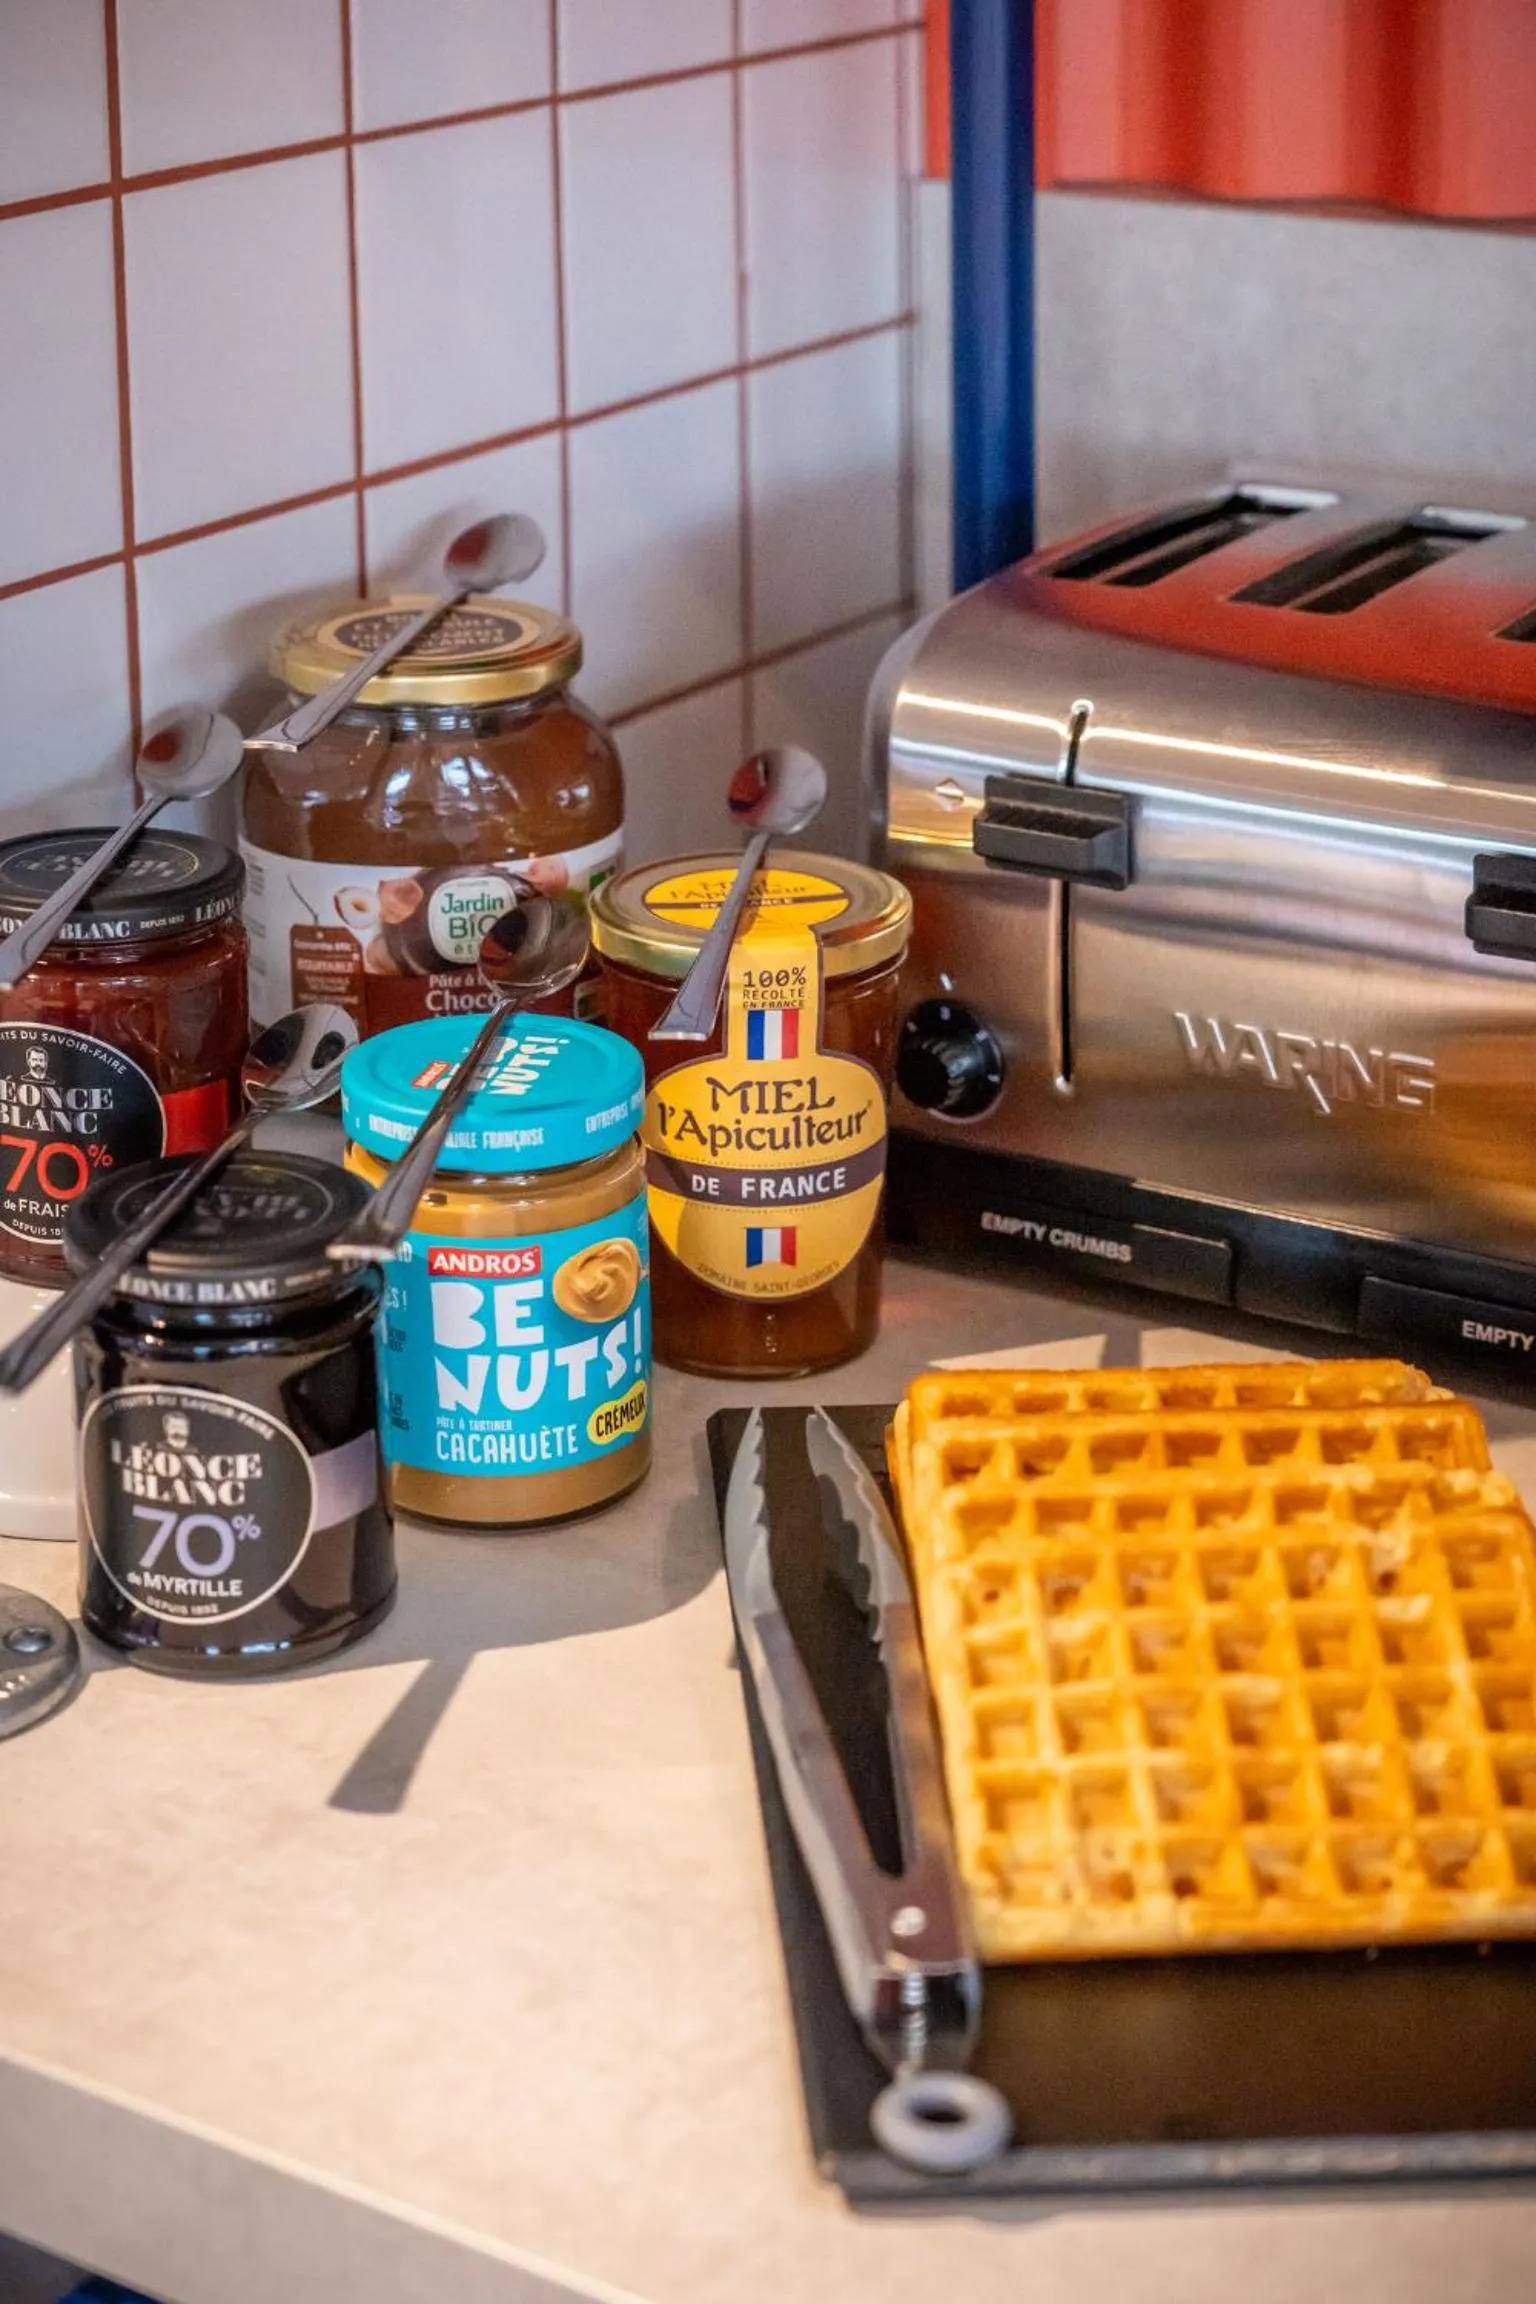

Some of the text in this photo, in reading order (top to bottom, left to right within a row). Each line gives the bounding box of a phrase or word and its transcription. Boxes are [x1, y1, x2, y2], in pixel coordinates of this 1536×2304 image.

[441, 891, 504, 914] Jardin
[59, 920, 130, 939] BLANC
[429, 974, 462, 989] Pâte
[465, 974, 474, 987] à
[743, 965, 807, 988] 100%
[425, 989, 501, 1012] Choco
[743, 999, 805, 1010] EN FRANCE
[20, 1030, 38, 1040] DU
[41, 1031, 127, 1075] SAVOIR-FAIRE
[487, 1035, 571, 1096] NUTS!
[0, 1075, 114, 1110] ÉONCE
[706, 1076, 835, 1115] MIEL
[368, 1112, 419, 1142] ENTREPRIS
[483, 1127, 544, 1152] FRANÇAISE
[658, 1098, 873, 1157] l'Apiculteur
[1, 1133, 114, 1200] 70%
[692, 1166, 847, 1199] DE FRANCE
[4, 1199, 70, 1218] de FRAIS
[12, 1218, 47, 1236] DEPUIS
[980, 1211, 1133, 1263] EMPTY CRUMBS
[432, 1251, 536, 1273] ANDROS
[118, 1270, 193, 1303] ÉONCE
[197, 1276, 278, 1303] BLANC
[430, 1278, 545, 1350] BE
[1462, 1319, 1535, 1352] EMPTY
[434, 1306, 643, 1416] NUTS!
[110, 1439, 263, 1481] LÉONCE
[436, 1424, 579, 1464] CACAHUÈTE
[122, 1467, 246, 1507] BLANC
[132, 1504, 262, 1578] 70%
[143, 1571, 244, 1597] MYRTILLE
